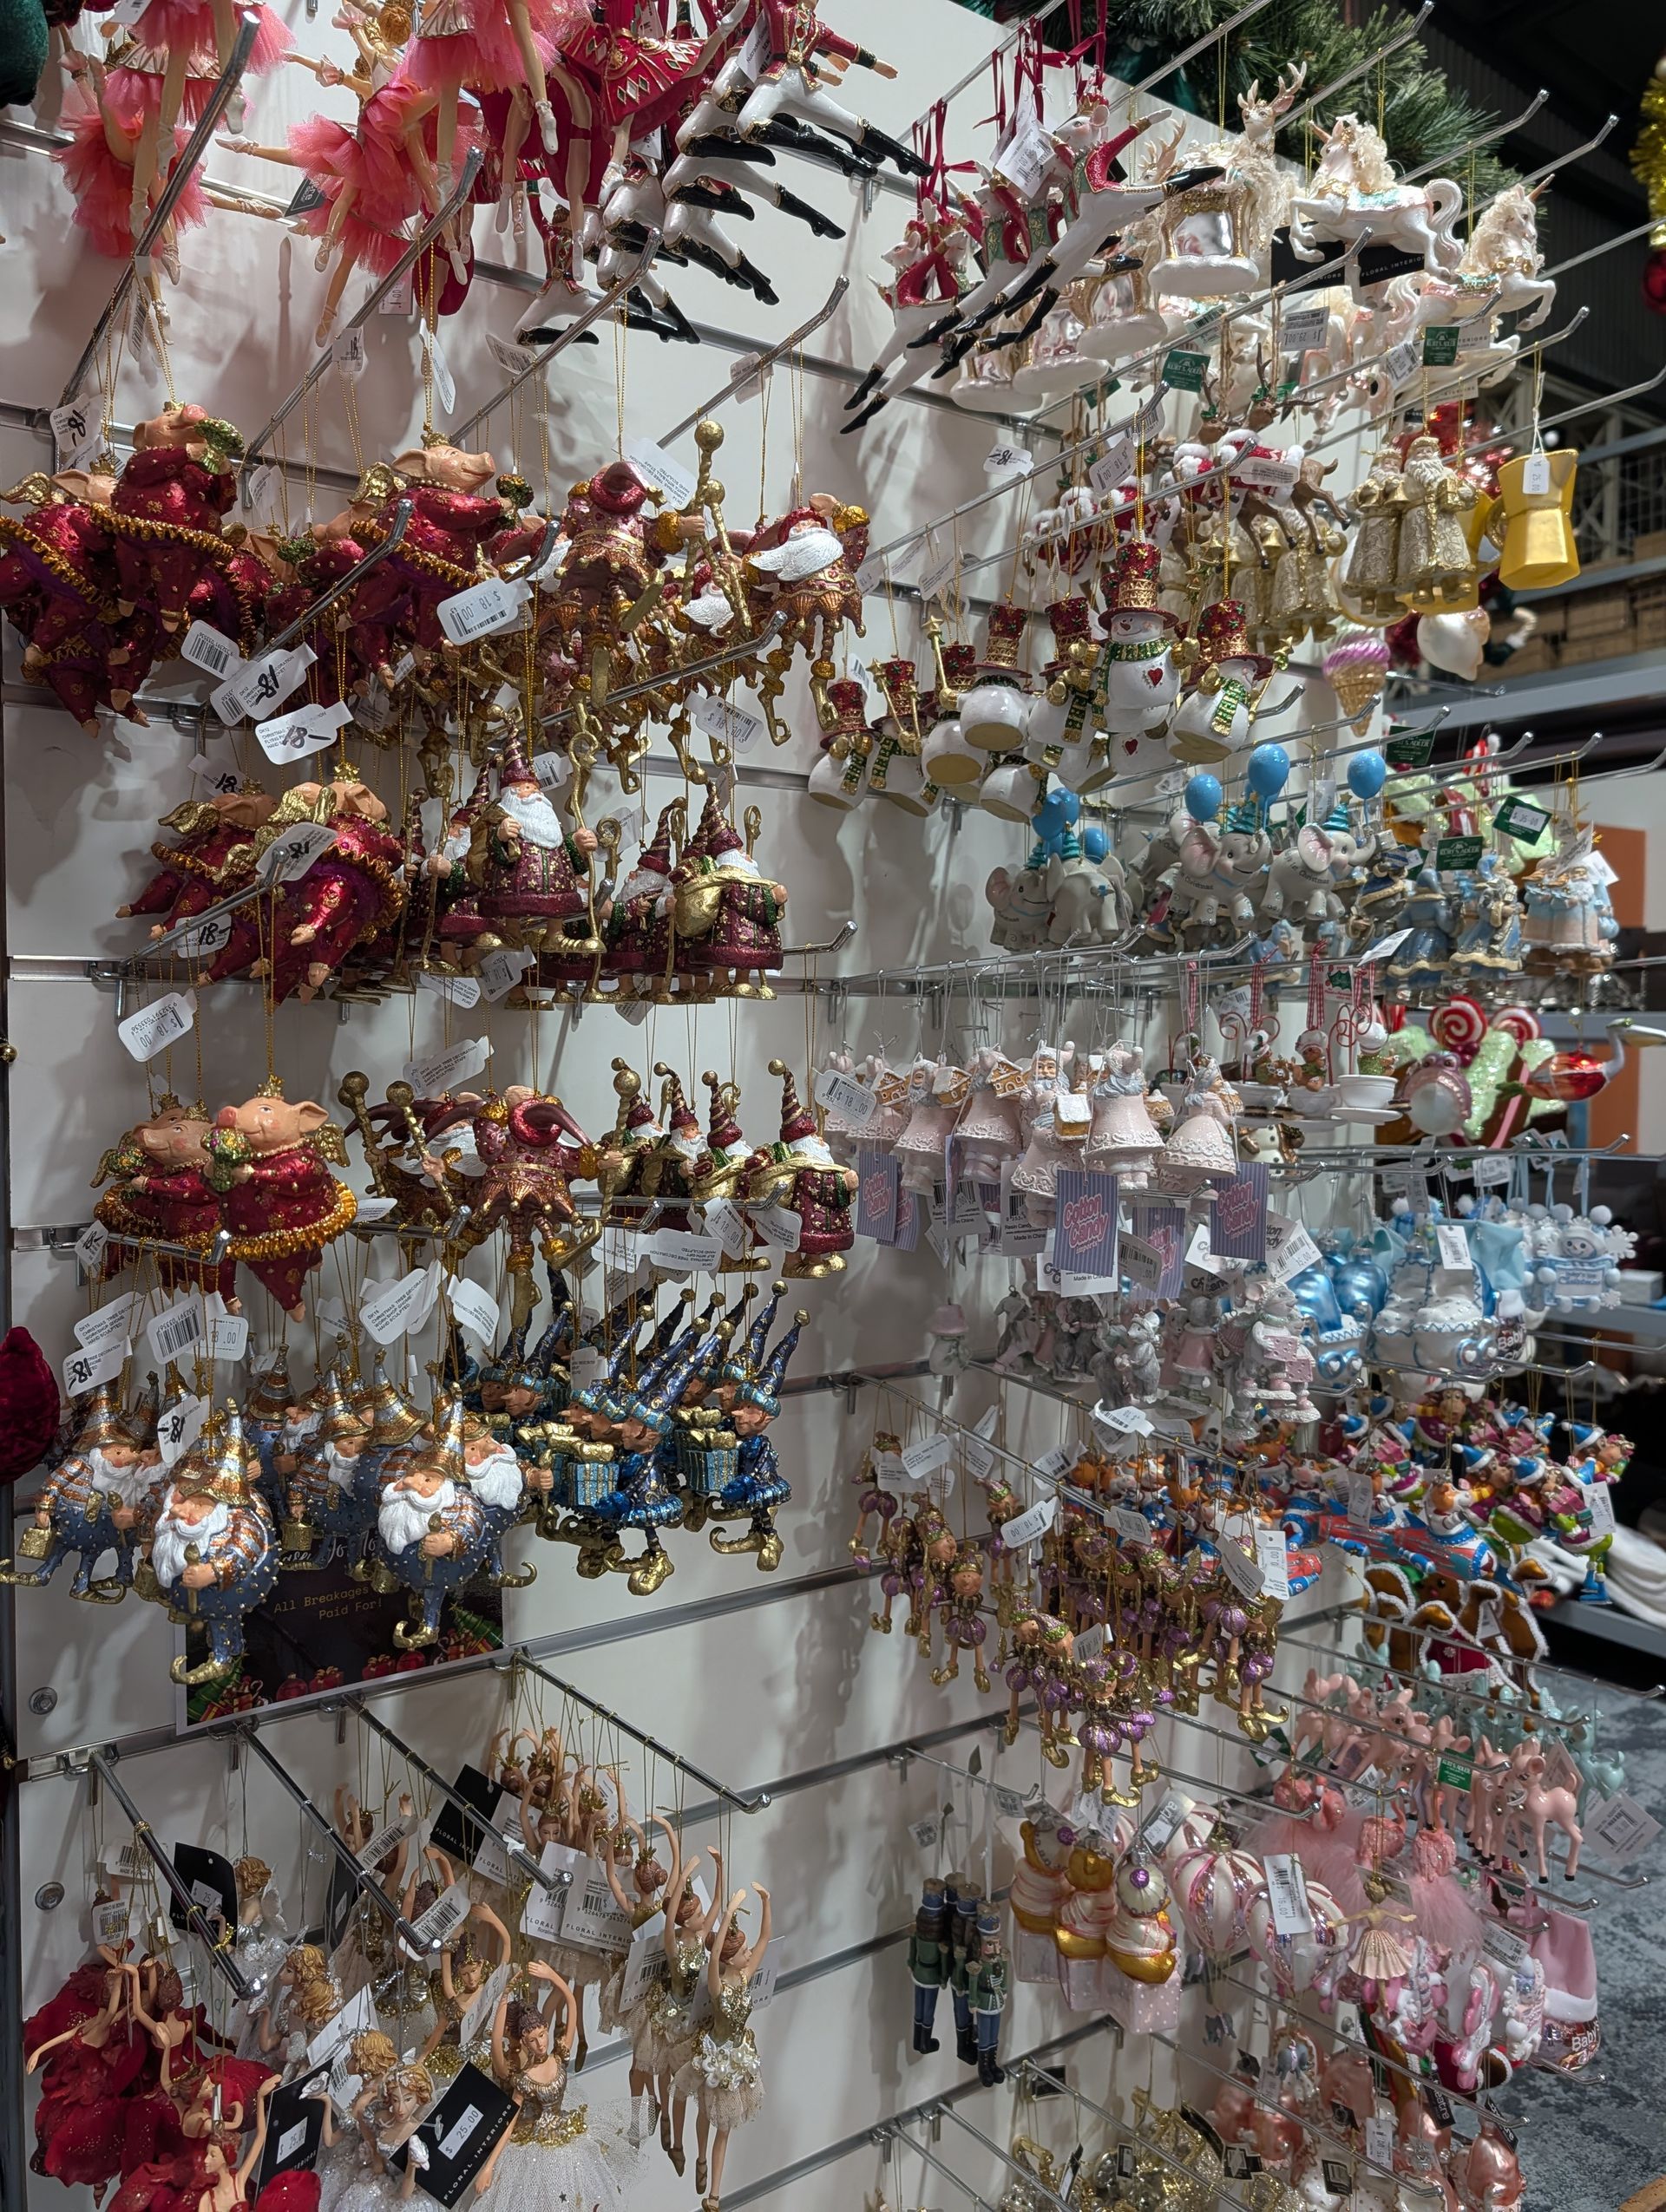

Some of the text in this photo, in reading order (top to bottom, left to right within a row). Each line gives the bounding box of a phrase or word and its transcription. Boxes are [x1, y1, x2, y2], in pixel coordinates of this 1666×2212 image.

[1361, 265, 1388, 277] FLORAL
[629, 453, 685, 502] CHRISTMAS TREE DECORATION
[644, 461, 687, 499] SANTA WITH BALL STAFF
[659, 467, 690, 495] HAND SCULPTED
[1300, 869, 1330, 885] Christmas
[421, 1064, 443, 1079] CHRISTMAS
[452, 1044, 477, 1061] DECORATION
[423, 1073, 436, 1083] SANTA
[453, 1054, 466, 1064] STAFF
[424, 1066, 456, 1087] HAND SCULPTED
[1063, 1194, 1102, 1229] Cotton
[1217, 1181, 1253, 1216] Cotton
[1223, 1200, 1258, 1234] Candy
[1069, 1213, 1108, 1248] Candy
[649, 1250, 678, 1259] DECORATION
[681, 1247, 705, 1255] SCULPTED
[690, 1255, 713, 1264] CHRISTMAS
[371, 1304, 396, 1325] CHRISTMAS
[395, 1293, 407, 1305] TREE
[404, 1273, 431, 1296] DECORATION
[374, 1307, 399, 1328] WORKSHOP
[397, 1296, 412, 1309] GNOME
[82, 1320, 108, 1337] CHRISTMAS
[106, 1312, 119, 1322] TREE
[84, 1315, 125, 1340] WORKSHOP GNOME
[377, 1303, 411, 1332] HAND SCULPTED
[87, 1322, 123, 1345] HAND SCULPTED
[97, 1345, 122, 1358] DECORATION
[274, 1587, 370, 1613] All Breakages
[319, 1597, 382, 1620] Paid For!
[435, 1828, 457, 1846] FLORAL
[479, 1856, 504, 1874] FLORAL
[566, 1923, 632, 1944] FLORAL INTERIO
[444, 2109, 482, 2154] $ 25.00
[443, 2103, 513, 2200] FLORAL INTERIORS
